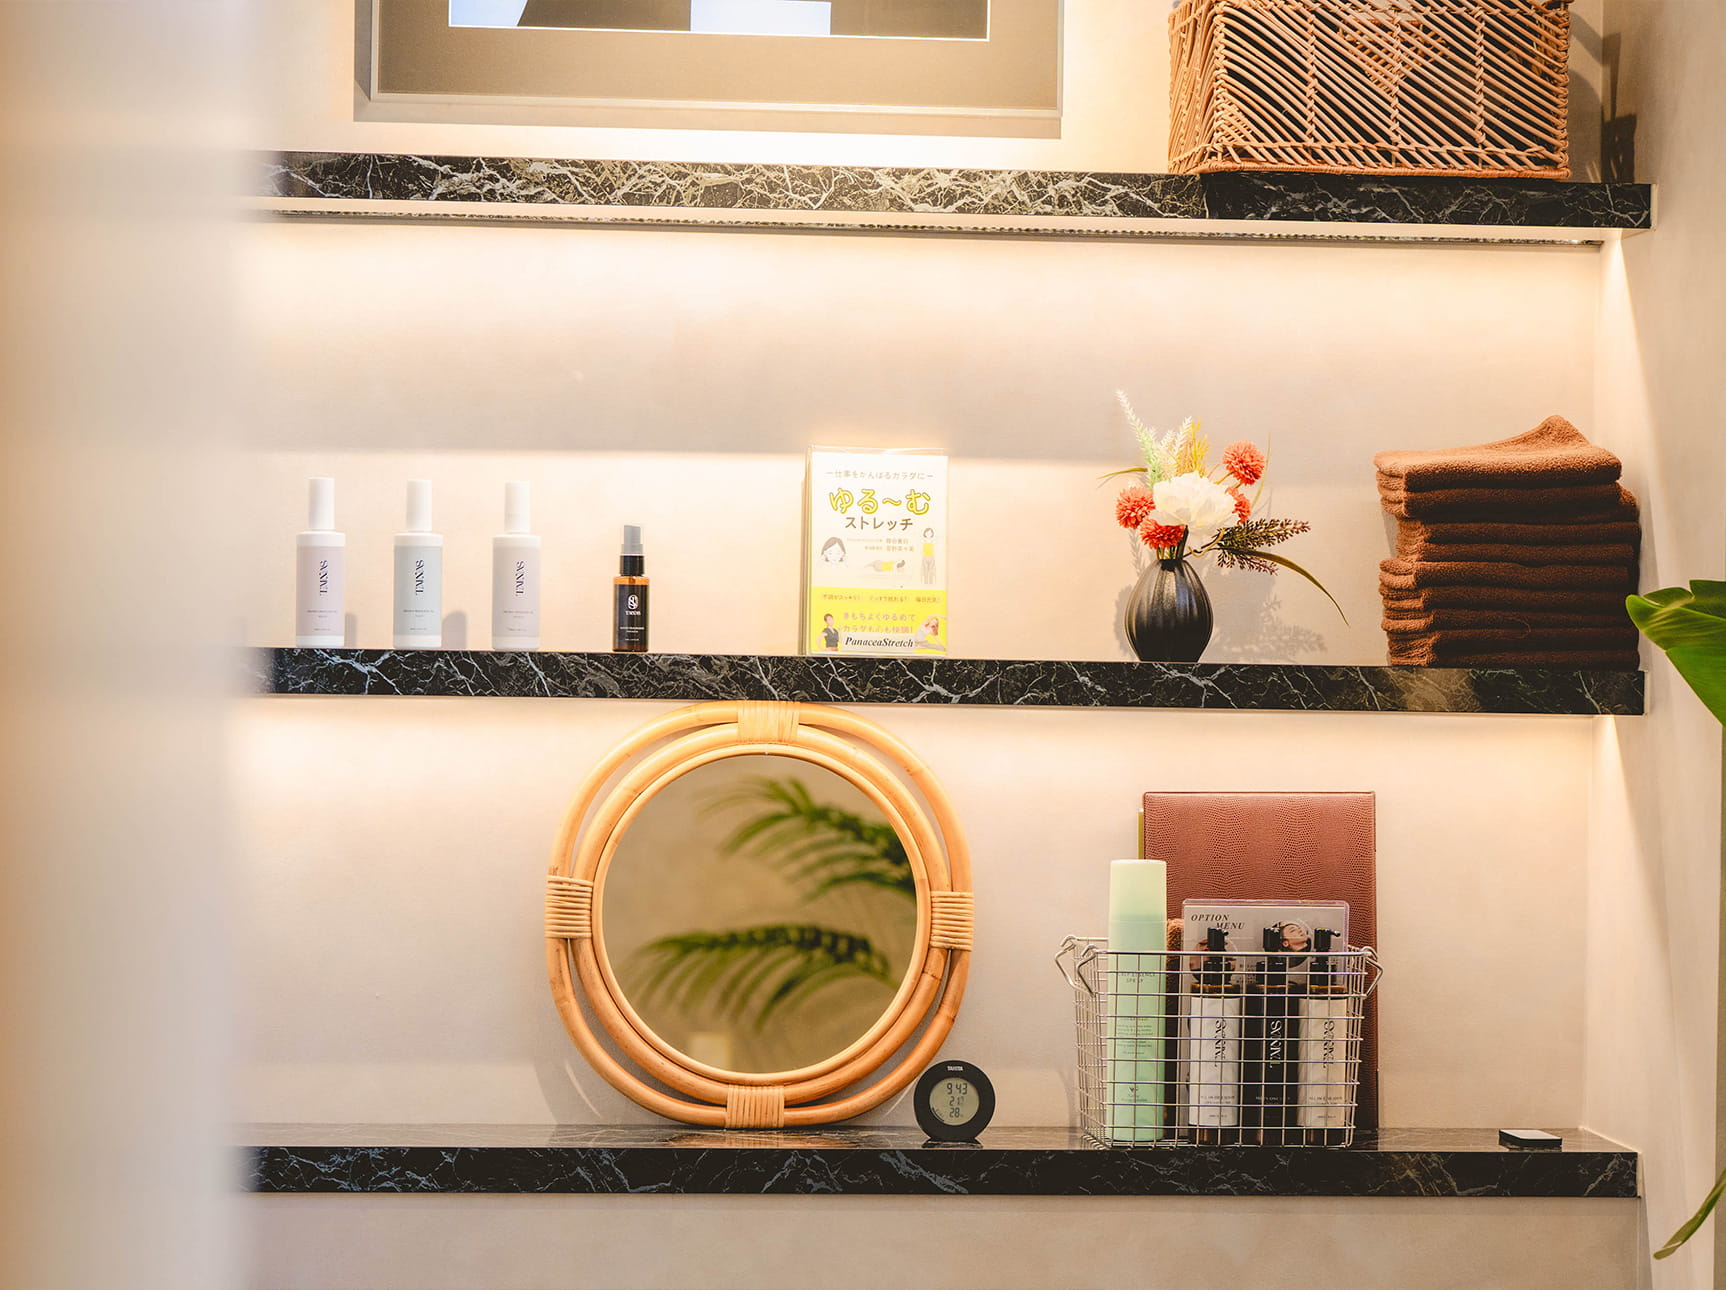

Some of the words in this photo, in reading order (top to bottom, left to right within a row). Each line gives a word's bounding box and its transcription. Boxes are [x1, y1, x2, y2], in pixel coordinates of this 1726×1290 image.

[845, 516, 913, 531] ストレッチ
[845, 636, 914, 648] PanaceaStretch
[1190, 913, 1230, 922] OPTION
[1215, 921, 1245, 930] MENU
